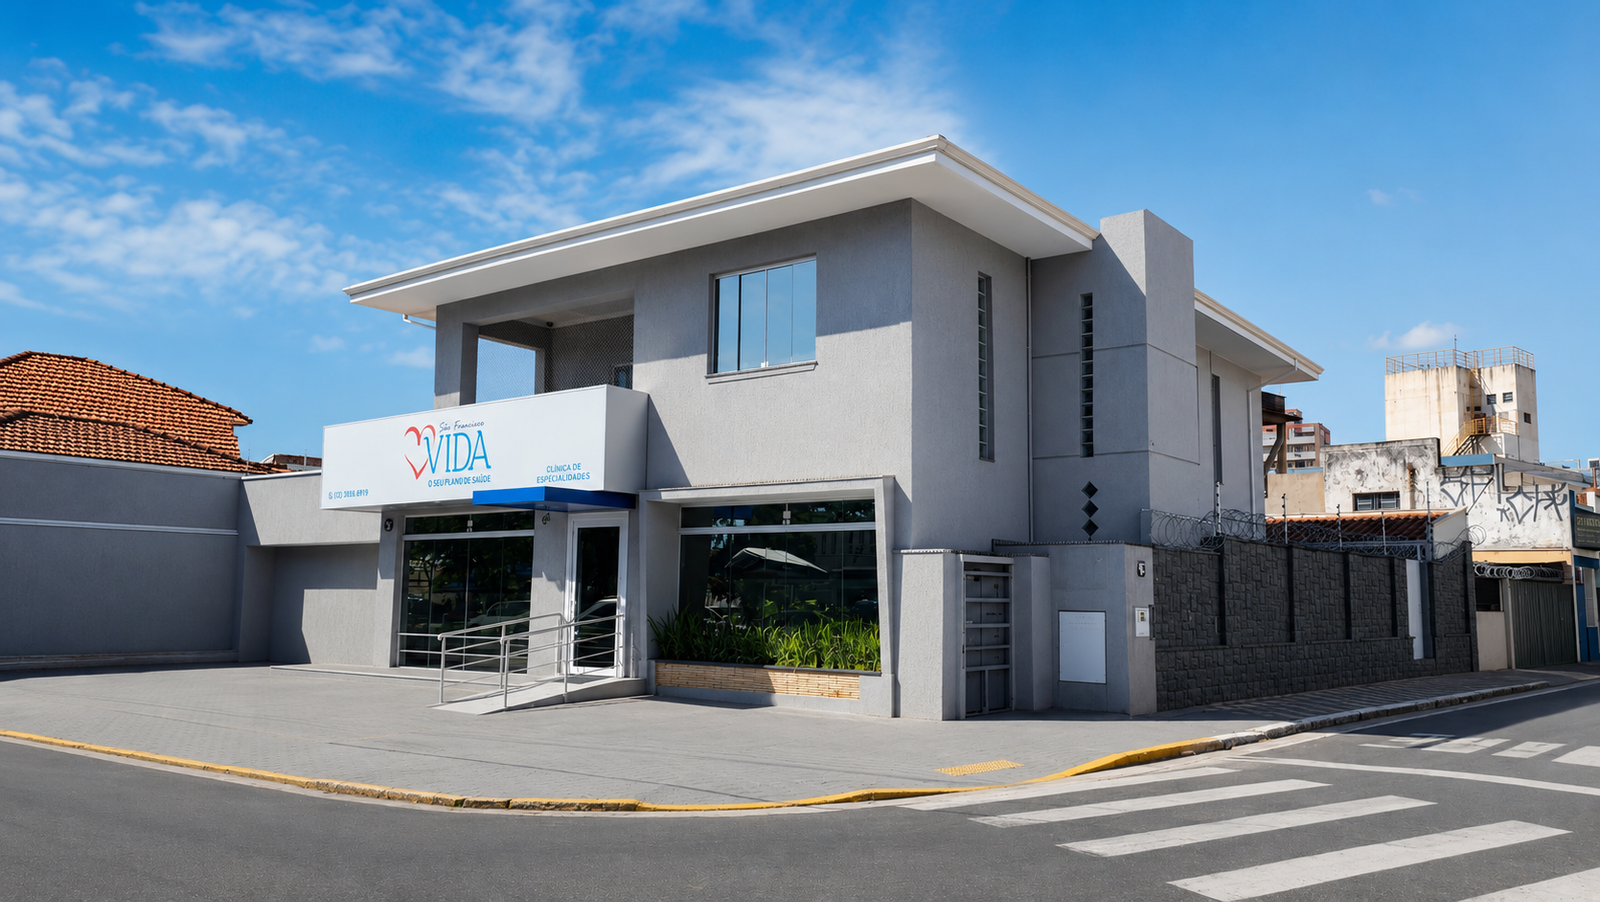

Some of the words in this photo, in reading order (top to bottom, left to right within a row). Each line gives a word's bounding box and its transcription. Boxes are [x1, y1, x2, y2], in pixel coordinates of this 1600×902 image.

[454, 420, 485, 430] Francisco
[423, 430, 492, 474] VIDA
[546, 464, 572, 473] CLÍNICA
[573, 463, 582, 471] DE
[428, 479, 433, 488] O
[433, 479, 444, 487] SEU
[445, 477, 463, 486] PLANO
[464, 476, 471, 485] DE
[537, 472, 590, 483] ESPECIALIDADES
